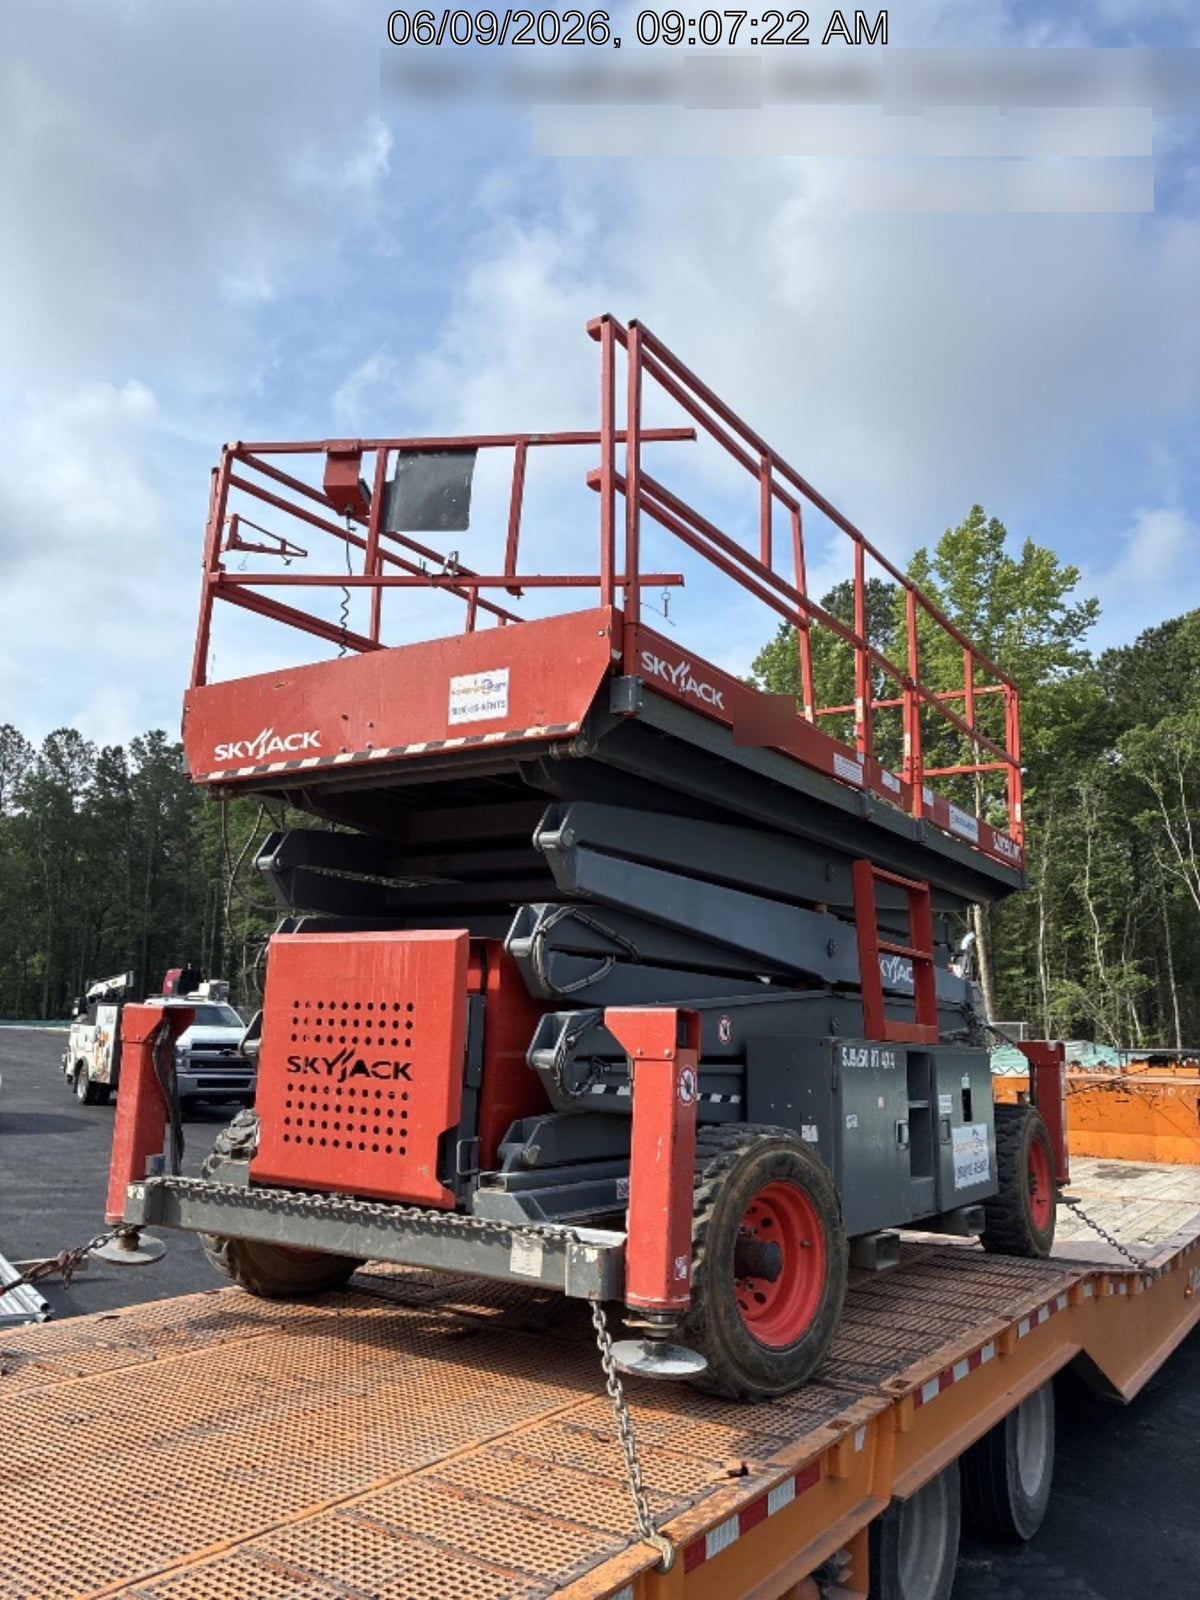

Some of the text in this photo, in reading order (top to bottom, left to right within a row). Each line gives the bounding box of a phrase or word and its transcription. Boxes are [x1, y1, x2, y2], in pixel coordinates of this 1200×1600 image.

[641, 651, 725, 710] SKYJACK
[214, 727, 322, 761] SKYJACK
[286, 1047, 413, 1083] SKYJACK
